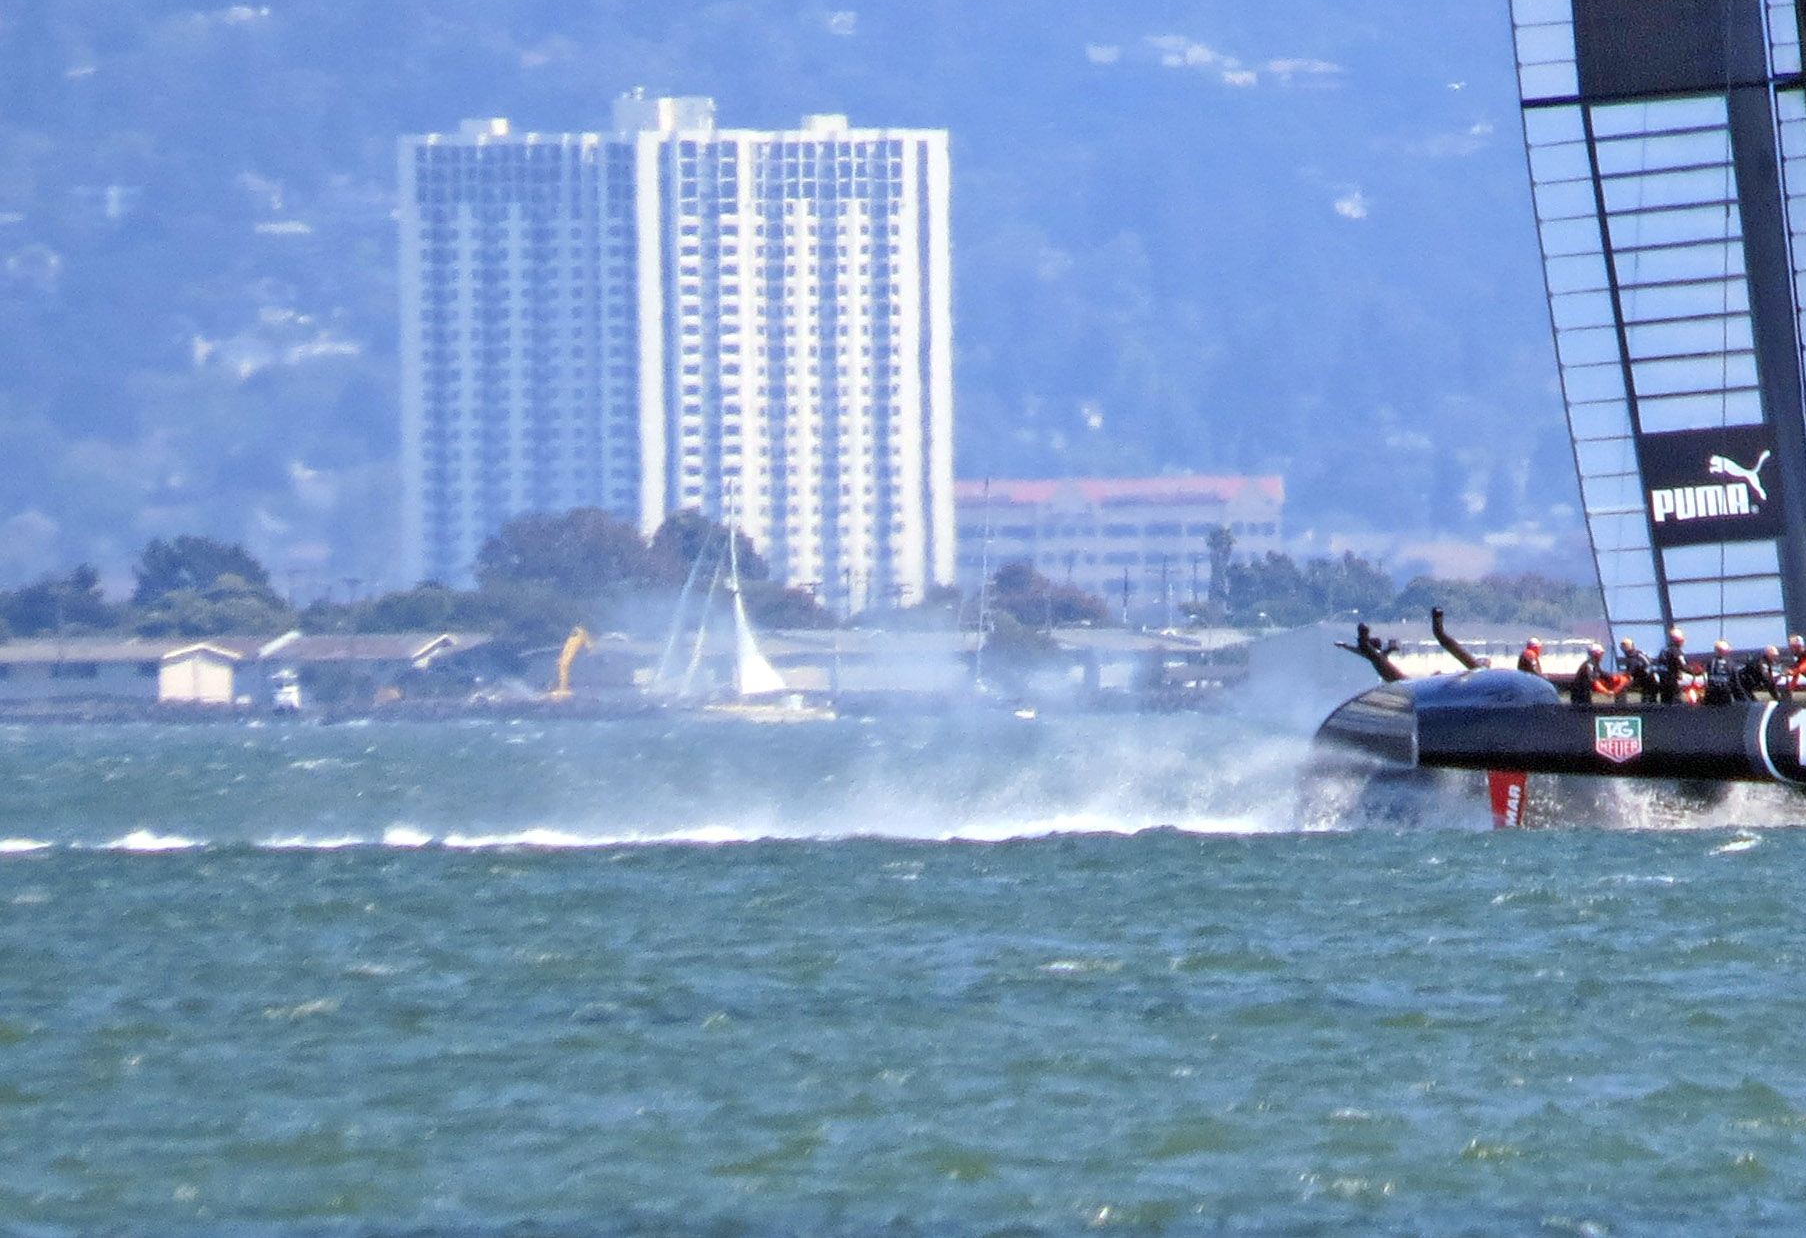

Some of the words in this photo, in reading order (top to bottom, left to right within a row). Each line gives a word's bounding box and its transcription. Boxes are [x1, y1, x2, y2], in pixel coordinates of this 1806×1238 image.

[1652, 483, 1750, 522] PUMA
[1604, 721, 1634, 738] TAG
[1600, 740, 1638, 758] HEUER
